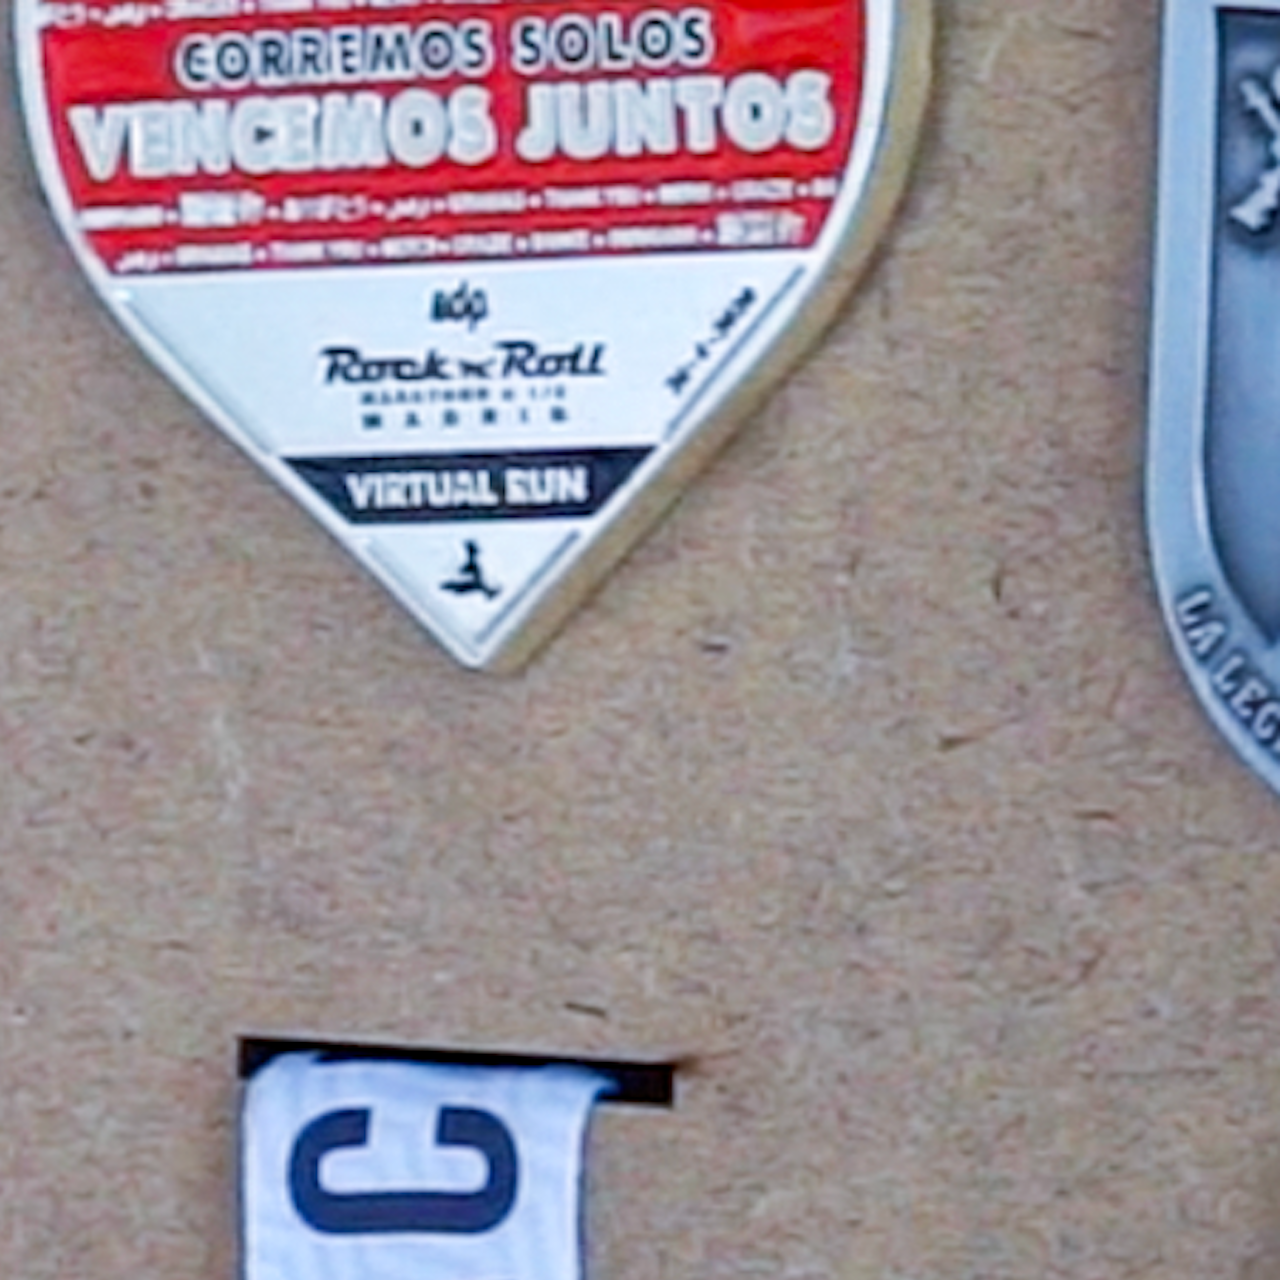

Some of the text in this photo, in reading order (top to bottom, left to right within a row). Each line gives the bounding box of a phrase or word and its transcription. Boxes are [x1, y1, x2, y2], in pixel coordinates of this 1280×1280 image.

[180, 21, 492, 88] CORREMOS
[513, 8, 712, 74] SOLOS
[67, 68, 833, 182] VENCEMOS JUNTOS
[320, 344, 450, 384] Rock
[495, 339, 608, 377] Roll
[345, 465, 590, 511] VIRTUAL RUN
[1177, 589, 1280, 752] LA LEG
